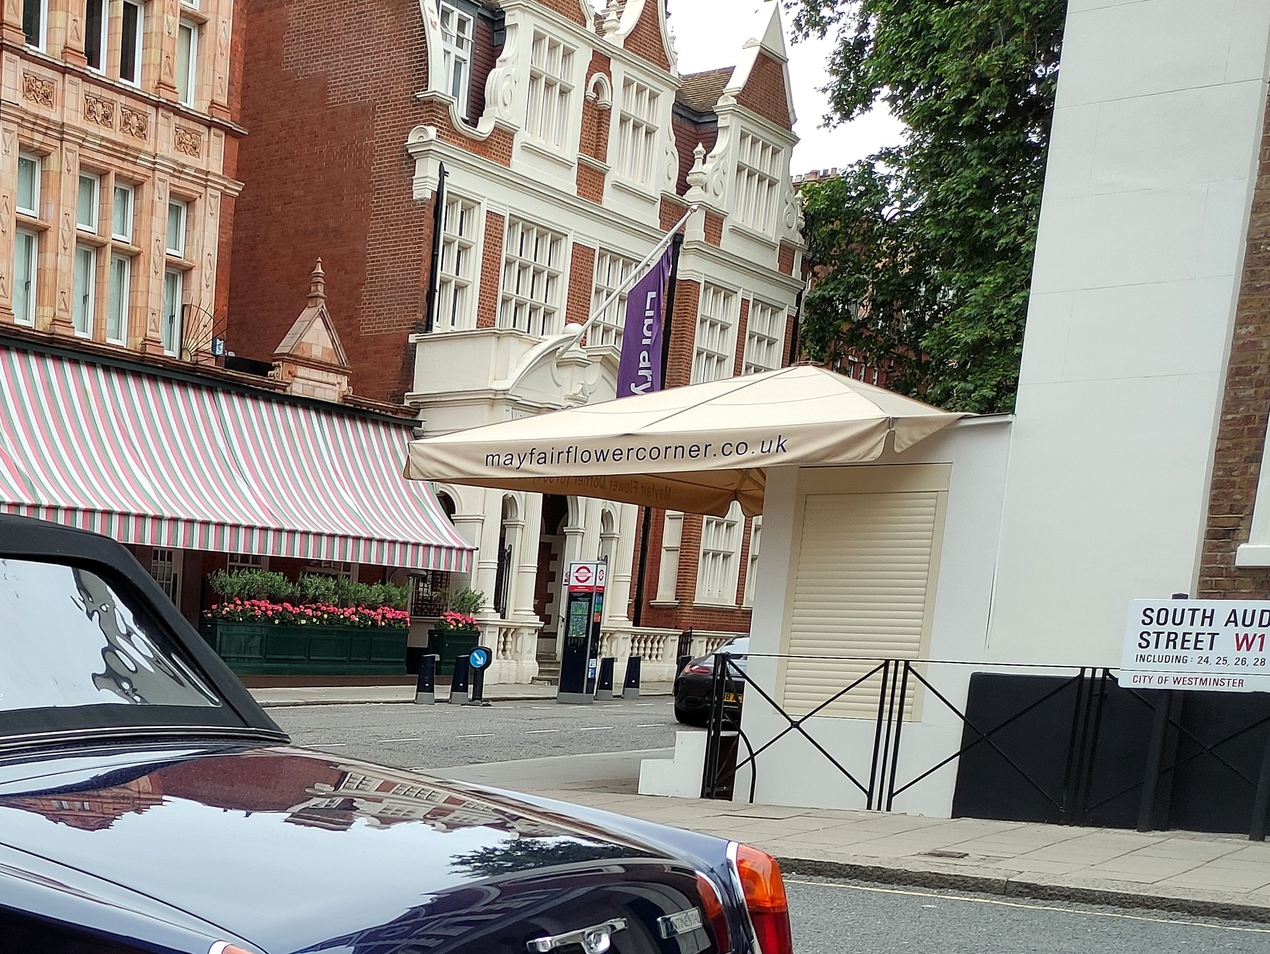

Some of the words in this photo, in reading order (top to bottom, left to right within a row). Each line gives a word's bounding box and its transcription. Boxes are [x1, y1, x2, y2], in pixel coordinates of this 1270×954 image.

[485, 434, 788, 470] mayfairflowercorner.co.uk
[1141, 607, 1216, 627] SOUTH
[1137, 631, 1220, 651] STREET
[1235, 632, 1266, 652] W1
[1132, 674, 1154, 685] CITY
[1157, 675, 1170, 686] OF
[1172, 676, 1245, 689] WESTMINSTER
